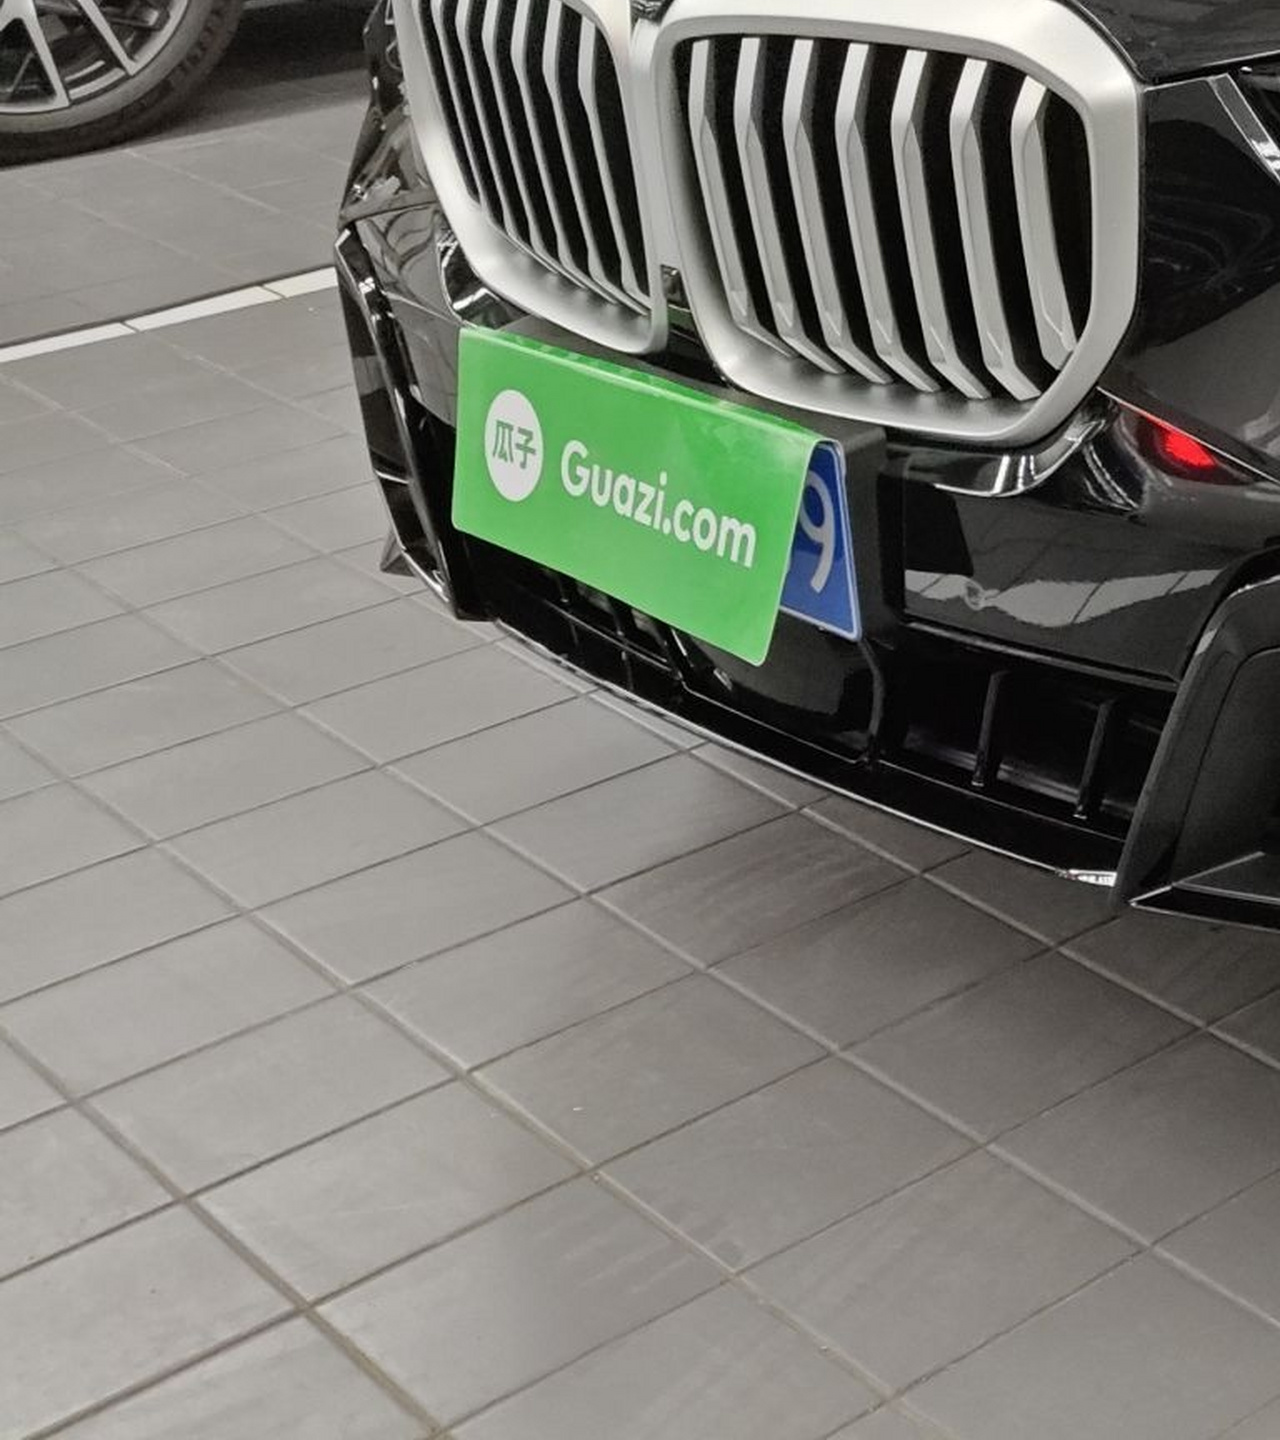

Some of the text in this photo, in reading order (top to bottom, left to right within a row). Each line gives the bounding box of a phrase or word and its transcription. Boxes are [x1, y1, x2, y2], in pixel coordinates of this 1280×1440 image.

[492, 419, 537, 470] 瓜子
[560, 439, 757, 569] Guazi.com
[799, 469, 836, 594] 9
